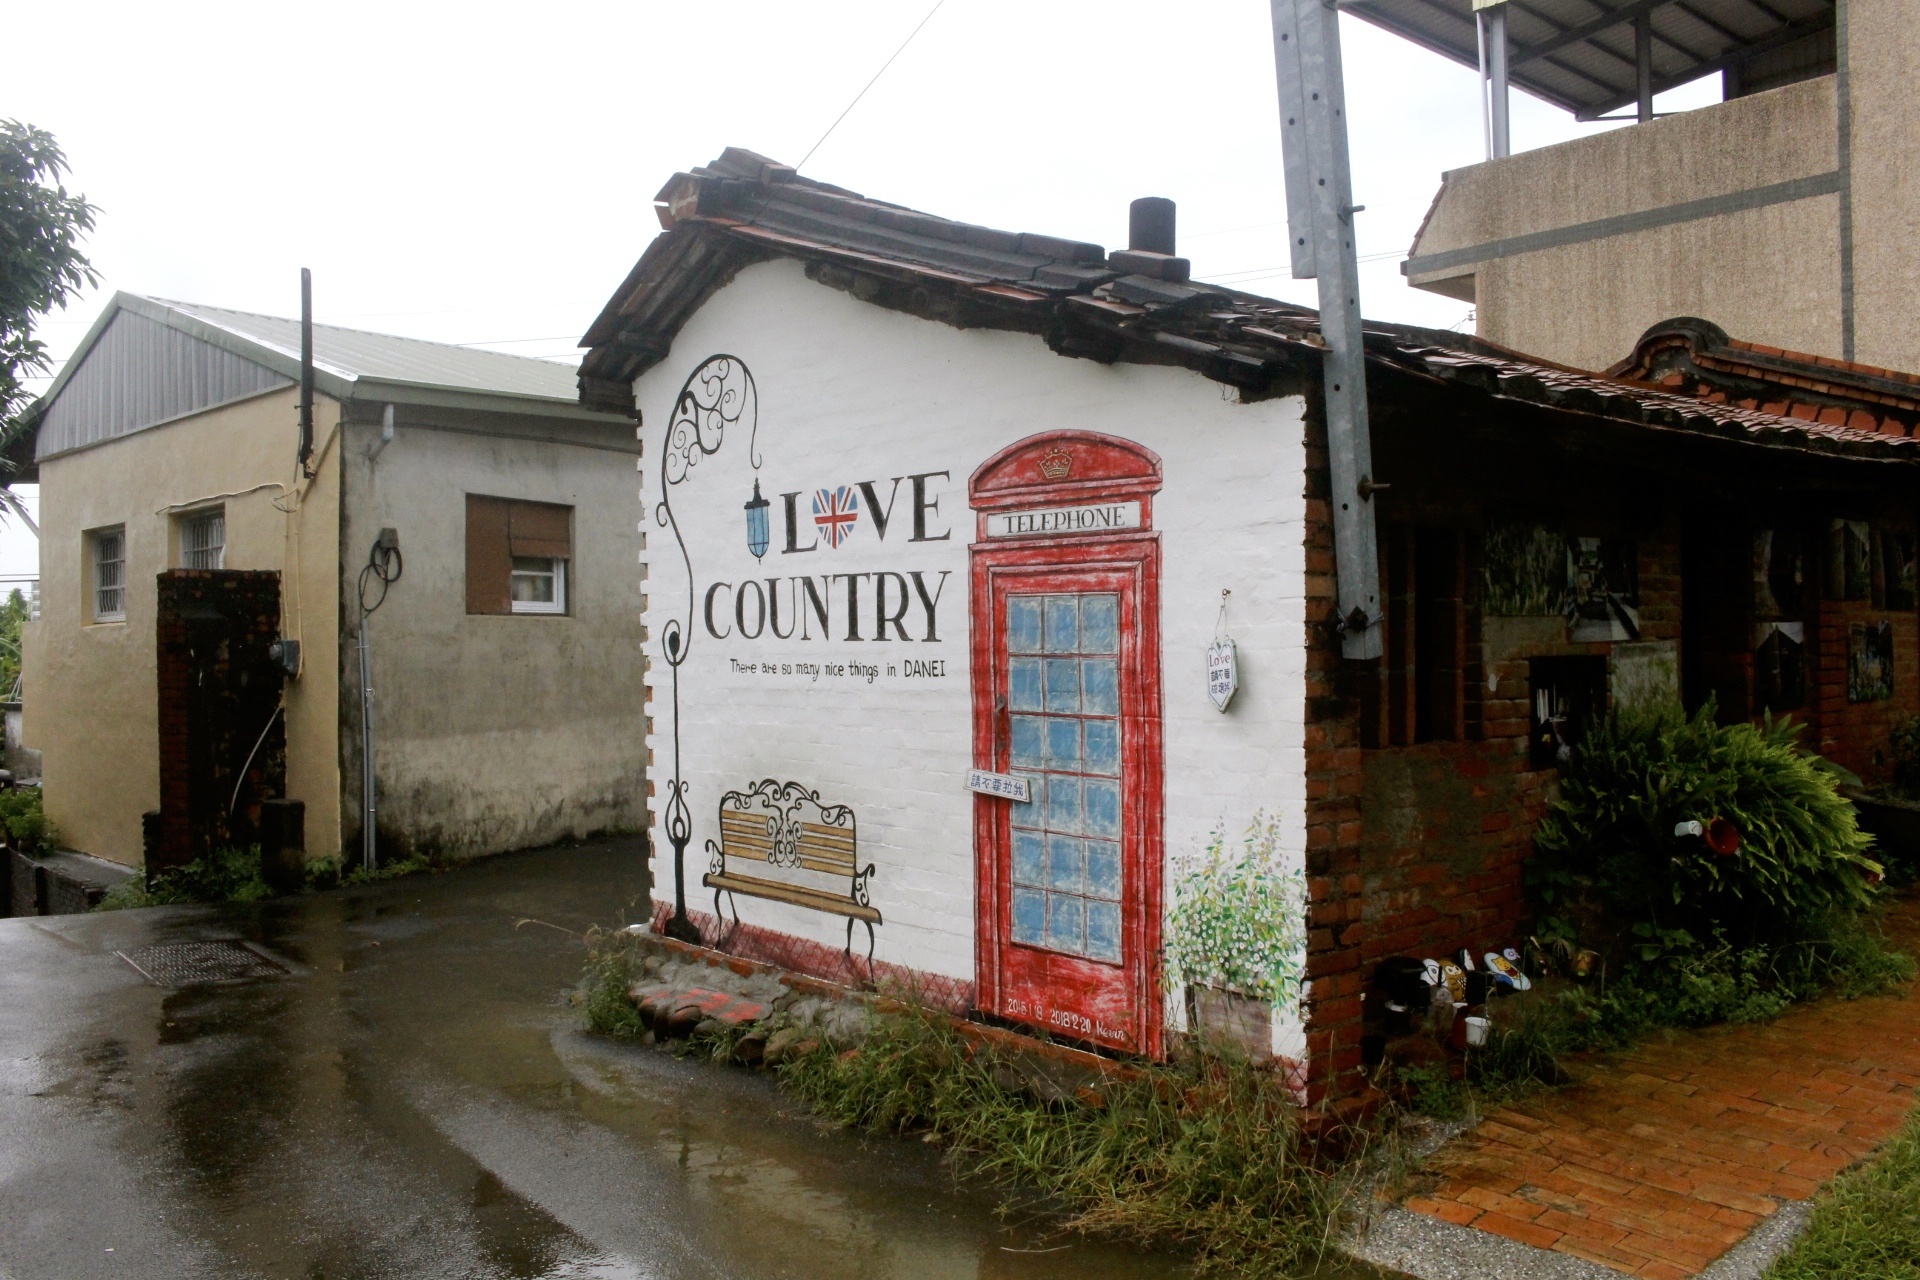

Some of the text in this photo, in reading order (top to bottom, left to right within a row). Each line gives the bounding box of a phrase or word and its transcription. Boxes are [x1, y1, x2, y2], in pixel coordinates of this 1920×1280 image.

[1002, 506, 1127, 535] TELEPHONE
[704, 570, 952, 642] COUNTRY
[729, 658, 946, 684] There are so many nice things in DANEI
[1209, 654, 1231, 667] Love
[970, 773, 1024, 797] 請不要拉我
[1050, 1008, 1071, 1028] 2018
